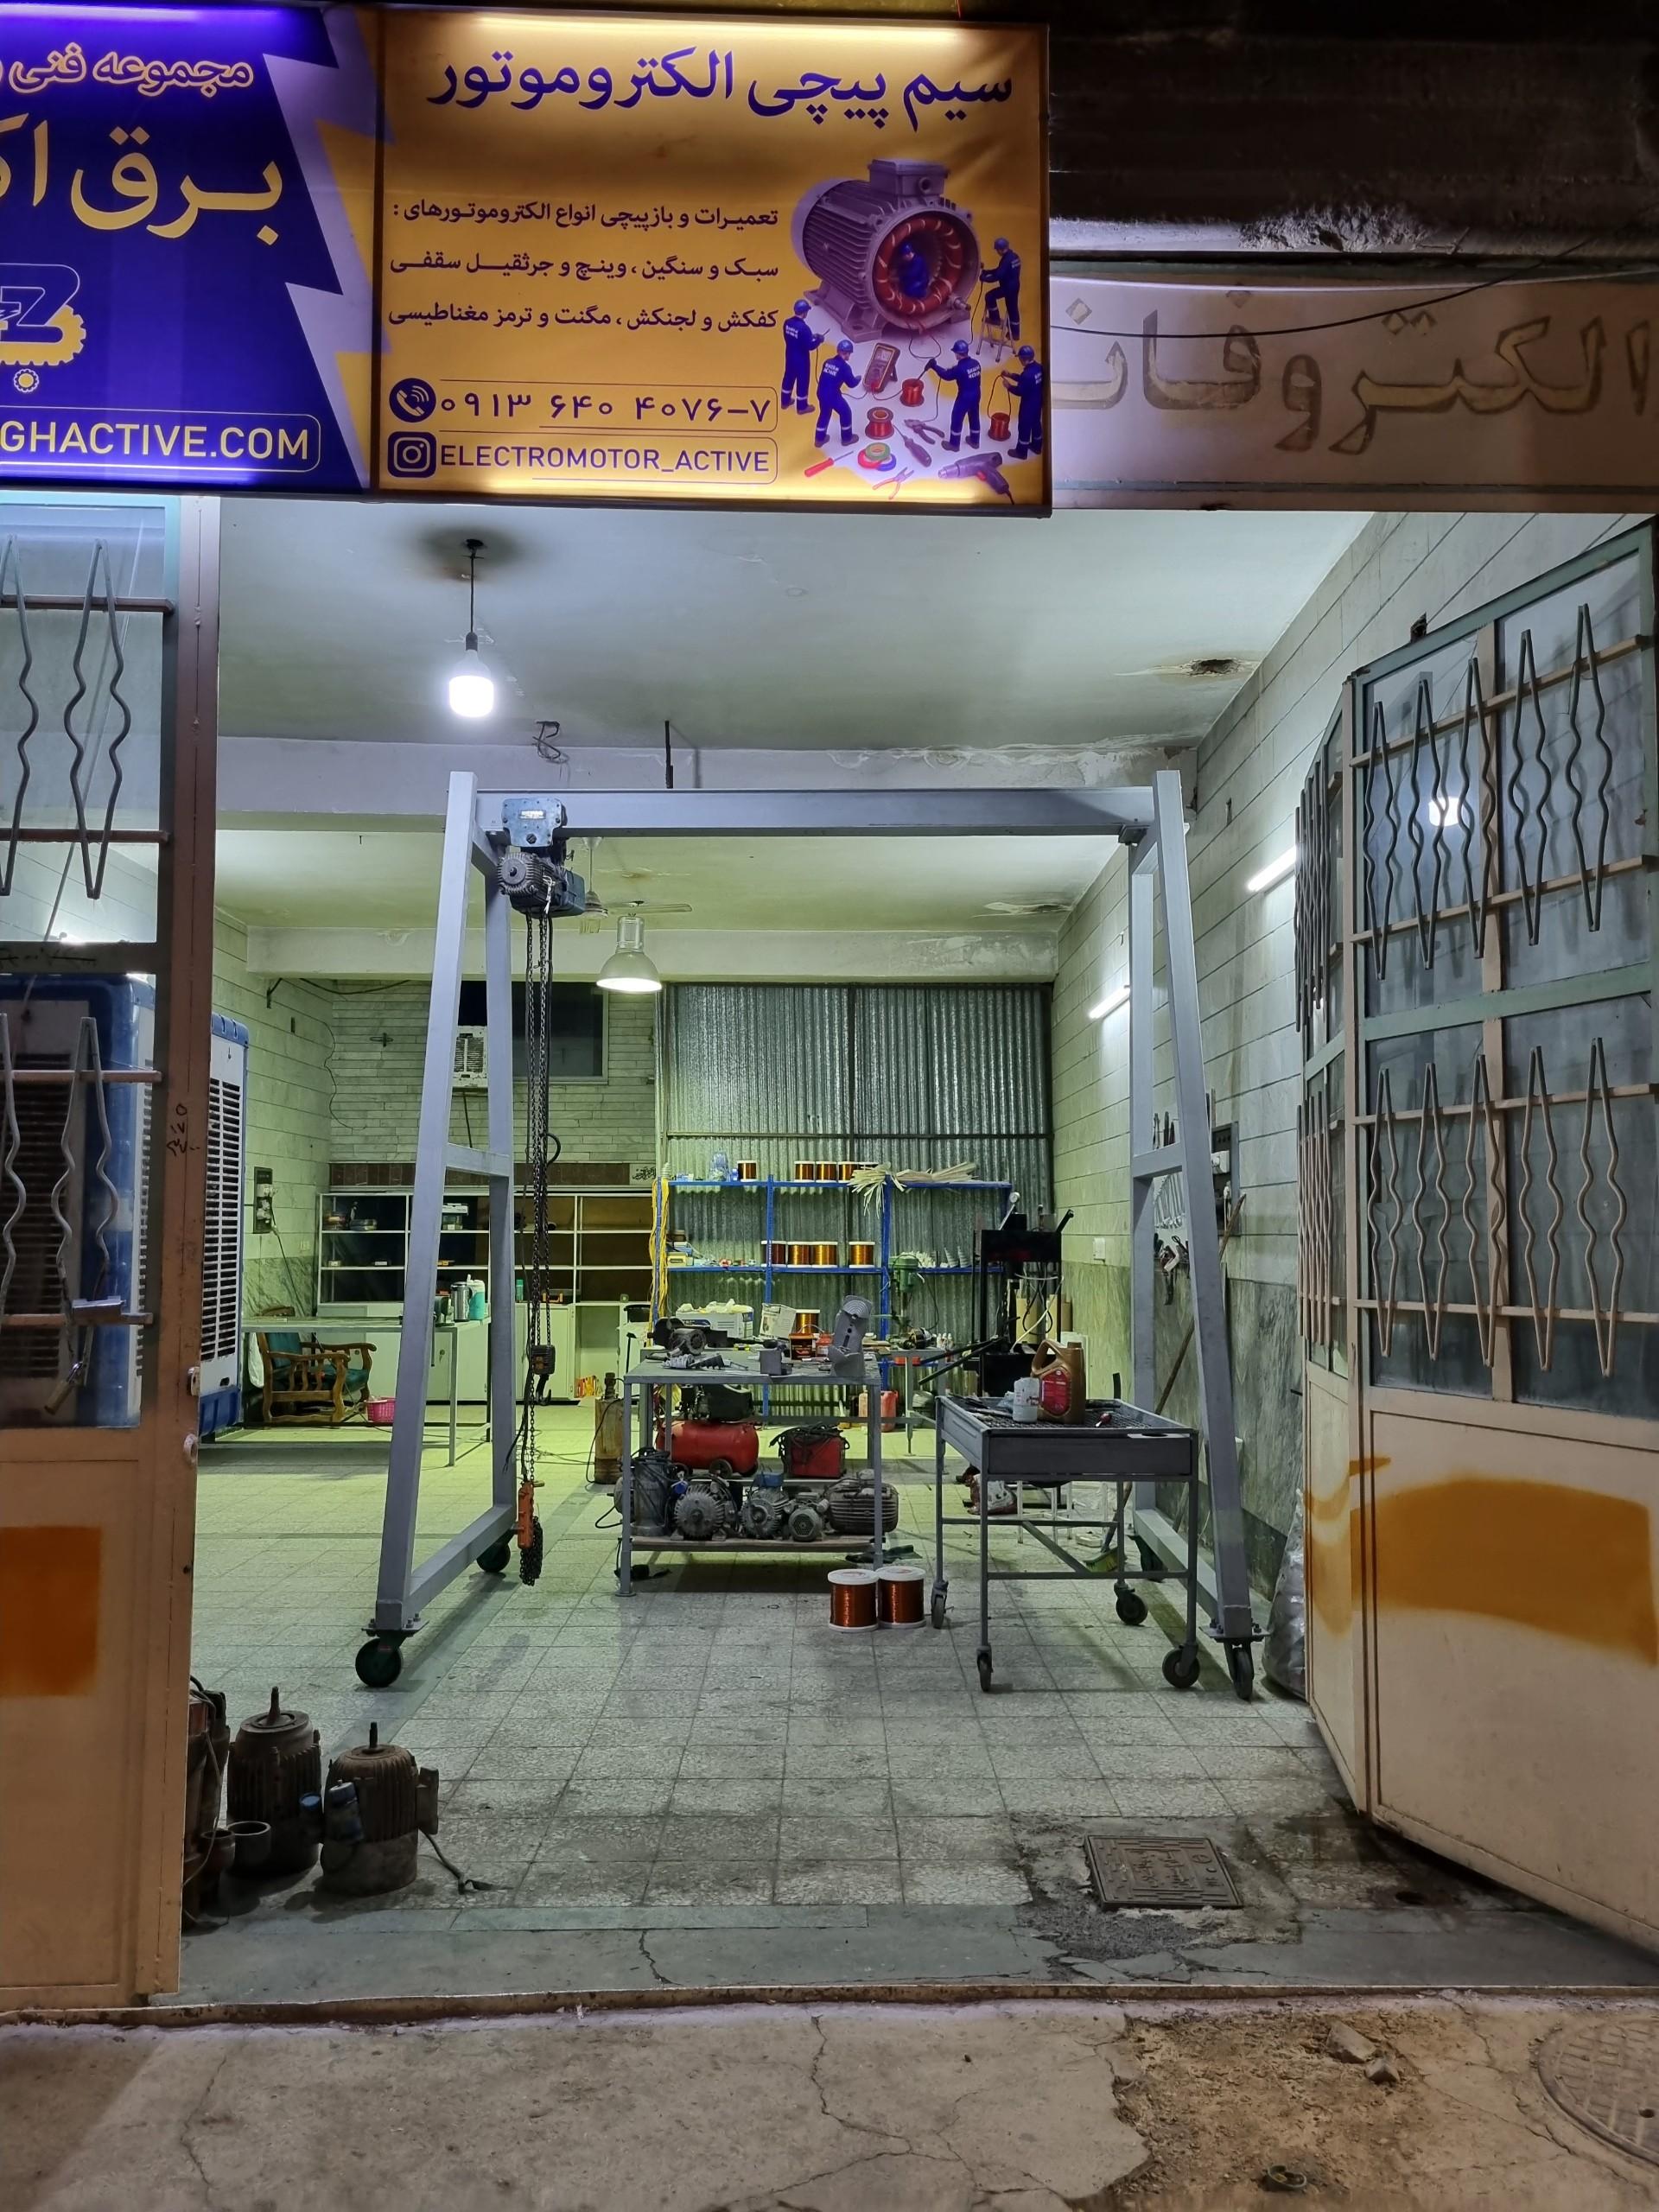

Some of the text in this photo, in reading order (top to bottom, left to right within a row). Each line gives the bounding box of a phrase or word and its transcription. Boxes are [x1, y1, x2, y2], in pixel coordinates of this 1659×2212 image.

[9, 41, 86, 93] فنی
[92, 51, 254, 97] مجموعه
[426, 46, 1012, 133] سیم پیچی الکتروموتور
[71, 126, 283, 245] برق
[556, 204, 595, 228] انواع
[677, 212, 690, 228] و
[695, 207, 779, 231] تعمیرات
[390, 251, 461, 273] سقفی
[466, 252, 554, 277] جرثقیل
[559, 261, 570, 276] و
[575, 259, 626, 281] وینچ
[708, 264, 720, 280] و
[724, 257, 779, 283] سبک
[389, 302, 489, 326] مغناطیسی
[493, 307, 532, 327] ترمز
[537, 313, 549, 327] و
[555, 305, 611, 325] مگنت
[701, 315, 713, 331] و
[718, 308, 779, 333] کفکش
[0, 420, 309, 460] GHACTIVE.COM
[441, 444, 771, 474] ELECTROMOTOR_ACTIVE
